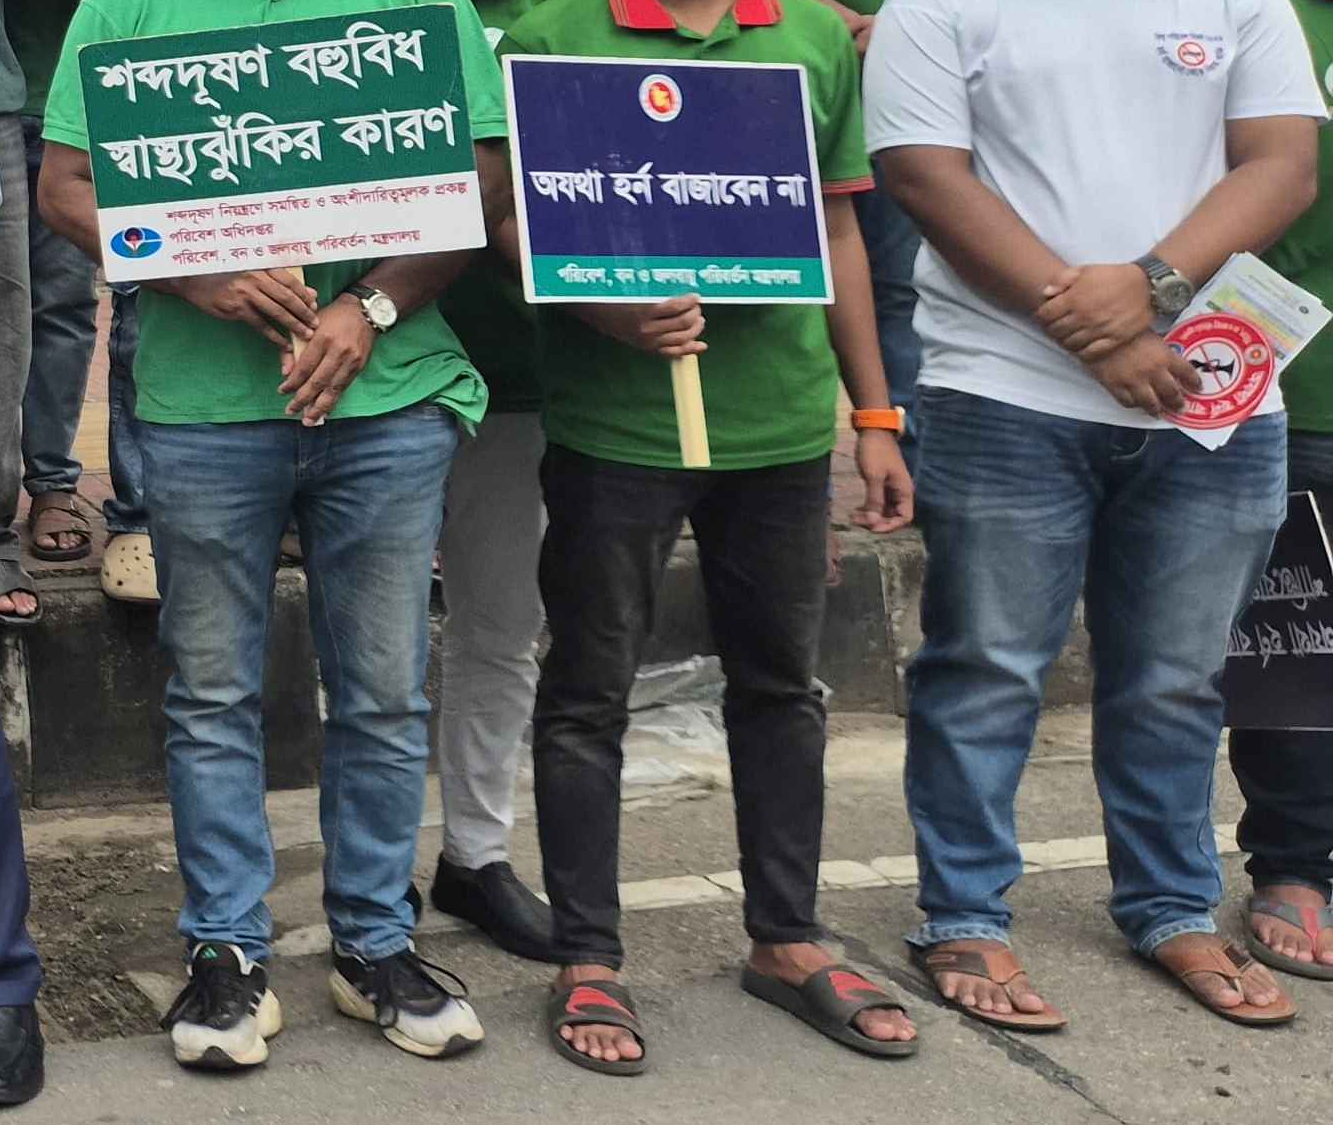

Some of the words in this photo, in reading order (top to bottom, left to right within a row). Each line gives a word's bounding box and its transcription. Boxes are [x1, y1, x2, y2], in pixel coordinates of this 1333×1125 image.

[94, 43, 271, 108] শব্দদূষণ
[282, 21, 427, 88] বহুবিধ
[99, 112, 324, 185] স্বাস্থ্যঝুঁকির
[334, 100, 459, 155] কারণ
[529, 168, 605, 204] অযথা
[610, 162, 654, 205] হর্ন
[657, 172, 769, 206] বাজাবেন
[773, 174, 807, 206] না
[317, 196, 325, 208] ও
[170, 228, 216, 244] পরিবেশ
[230, 248, 248, 261] বন
[255, 247, 264, 259] ও
[317, 234, 368, 253] পরিবর্তন
